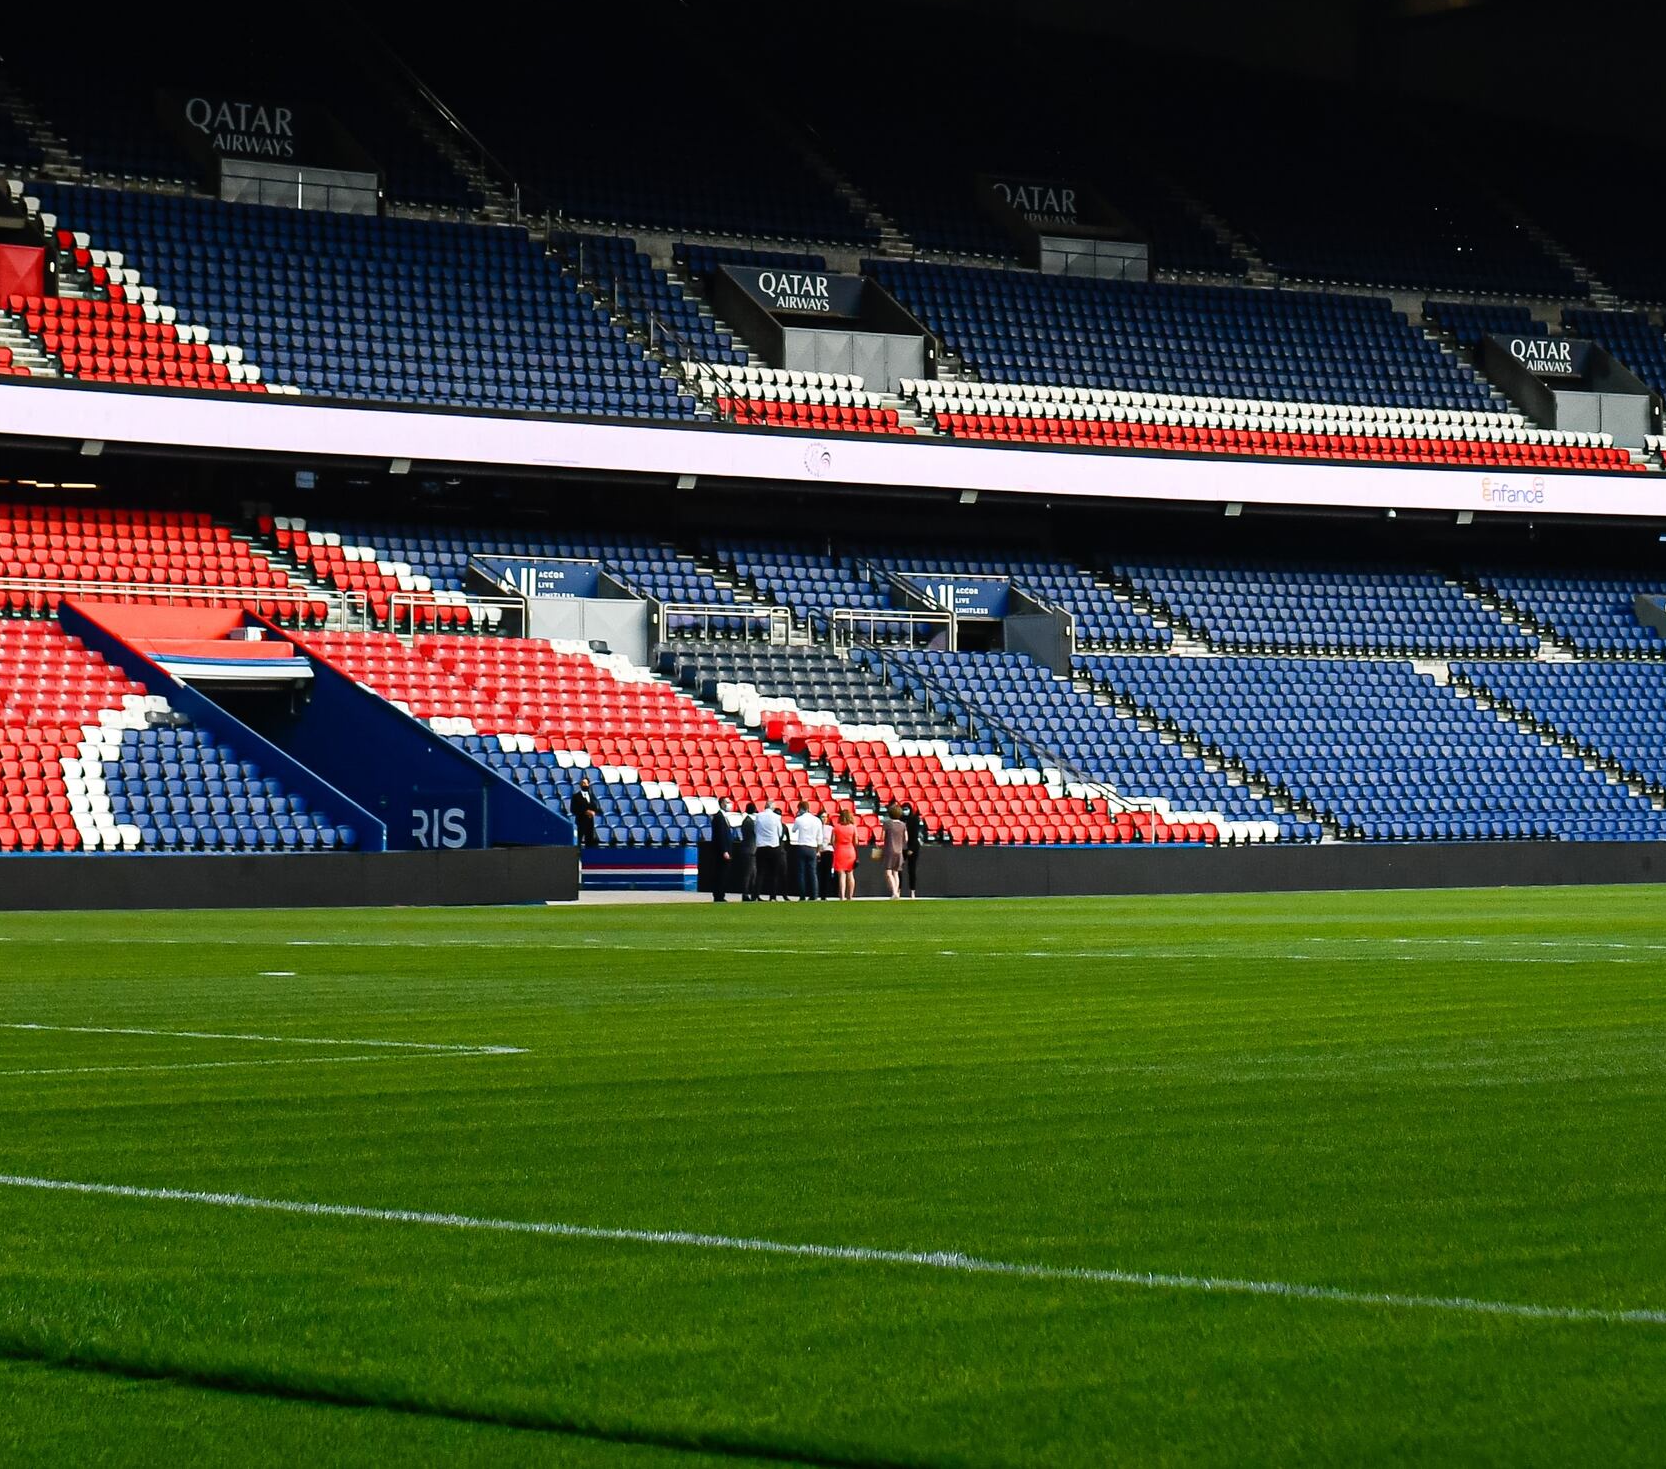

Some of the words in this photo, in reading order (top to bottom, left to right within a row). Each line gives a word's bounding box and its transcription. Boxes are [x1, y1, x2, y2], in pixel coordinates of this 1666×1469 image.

[186, 98, 293, 136] QATAR
[213, 133, 293, 157] AIRWAYS
[758, 272, 829, 297] QATAR
[776, 295, 830, 311] AIRWAYS
[1510, 339, 1571, 362] QATAR
[1526, 359, 1573, 373] AIRWAYS
[538, 571, 564, 579] ACCOR
[955, 607, 989, 615] LIMITLESS
